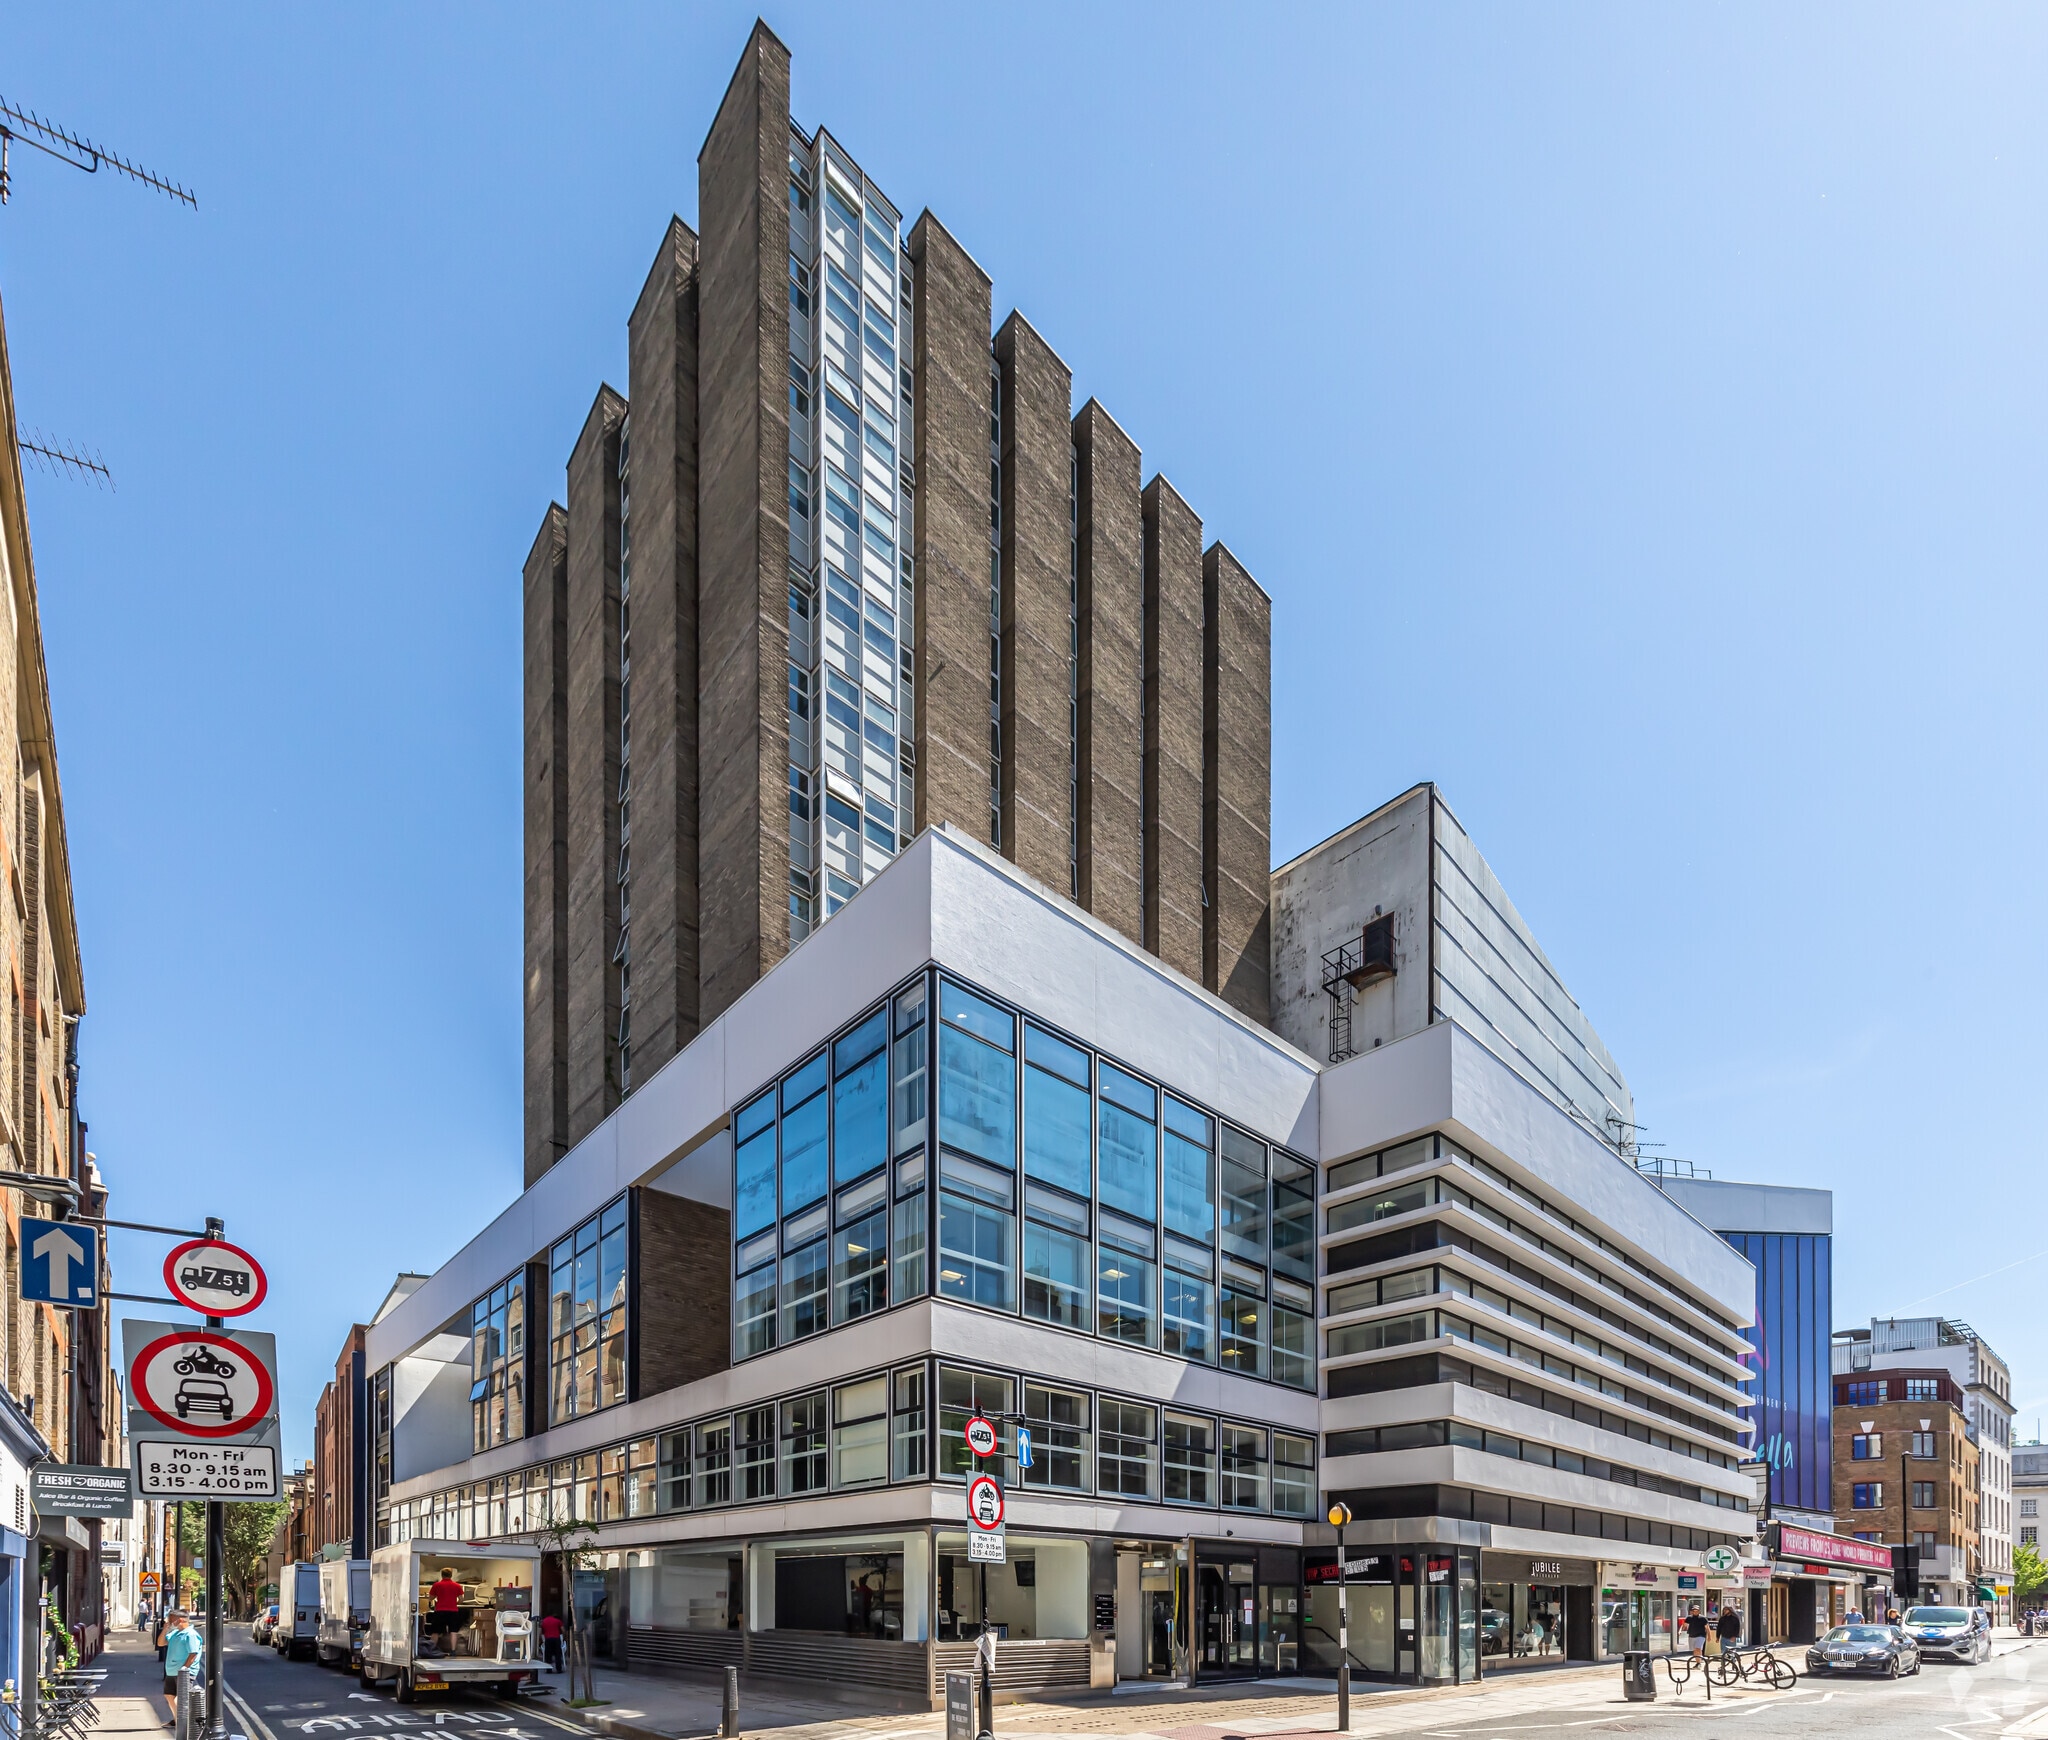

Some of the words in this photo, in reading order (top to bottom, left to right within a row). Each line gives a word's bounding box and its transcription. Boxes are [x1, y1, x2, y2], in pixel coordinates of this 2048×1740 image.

[173, 1449, 208, 1460] Mon
[223, 1450, 244, 1462] Fri
[150, 1463, 191, 1475] 8.30
[206, 1464, 238, 1476] 9.15
[244, 1467, 266, 1477] am
[38, 1475, 71, 1486] FRESH
[86, 1478, 126, 1489] ORGANIC
[149, 1477, 185, 1488] 3.15
[199, 1477, 239, 1489] 4.00
[244, 1480, 269, 1491] pm
[1785, 1533, 1809, 1551] PREVIEWS
[1810, 1538, 1824, 1553] FROM
[1320, 1565, 1339, 1578] SECR
[1345, 1557, 1379, 1568] comedy
[300, 1711, 516, 1734] AHEAD
